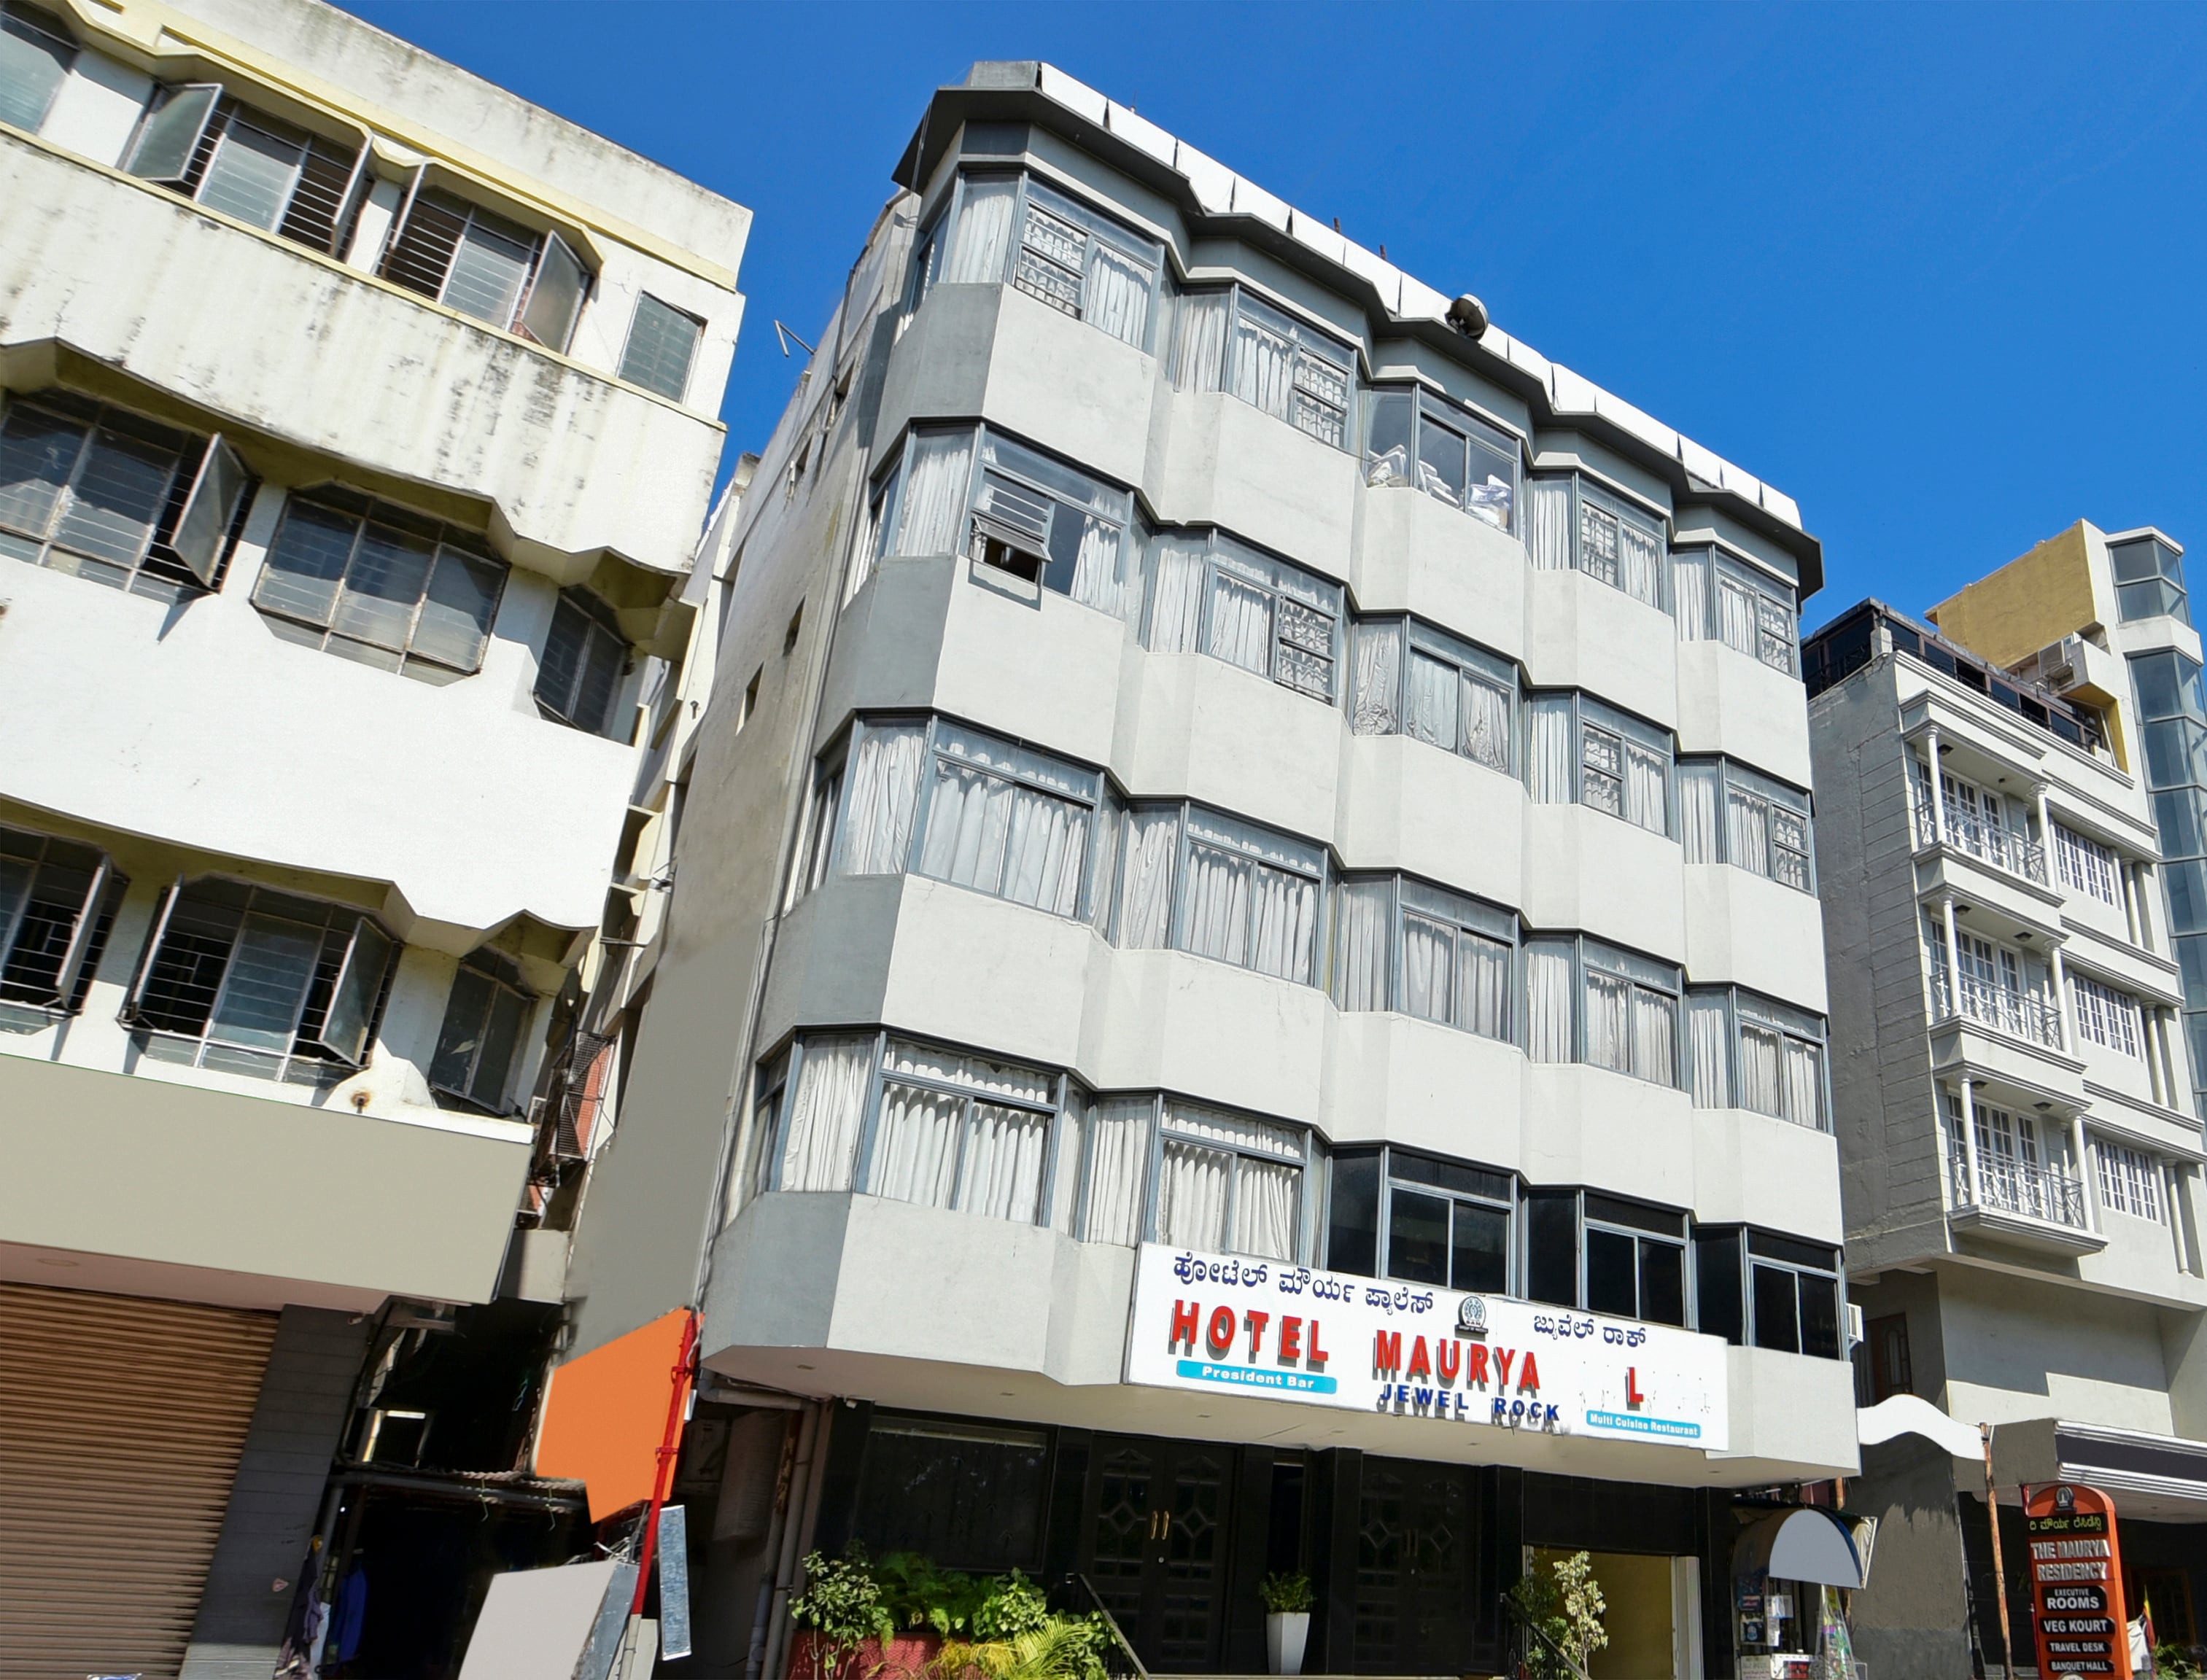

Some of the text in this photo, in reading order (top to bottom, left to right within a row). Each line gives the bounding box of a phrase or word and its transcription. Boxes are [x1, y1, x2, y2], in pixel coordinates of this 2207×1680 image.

[1173, 1251, 1268, 1287] ಹೋಟೆಲ್
[1279, 1267, 1355, 1302] ಮೌರ್ಯ
[1603, 1326, 1646, 1348] ರಾಕ್
[1170, 1299, 1644, 1403] HOTEL MAURYA L
[1202, 1366, 1314, 1389] President Bar
[1379, 1383, 1560, 1421] JEWEL ROCK
[1590, 1413, 1698, 1436] Multi Cuisine Restaurant
[2030, 1539, 2111, 1560] THE MAURYA
[2036, 1562, 2106, 1582] RESIDENCY
[2047, 1596, 2100, 1609] ROOMS
[2055, 1588, 2090, 1596] EXECUTIVE
[2043, 1619, 2108, 1633] VEG KOURT
[2049, 1642, 2105, 1652] TRAVEL DESK
[2051, 1661, 2108, 1671] BANQUET HALL
